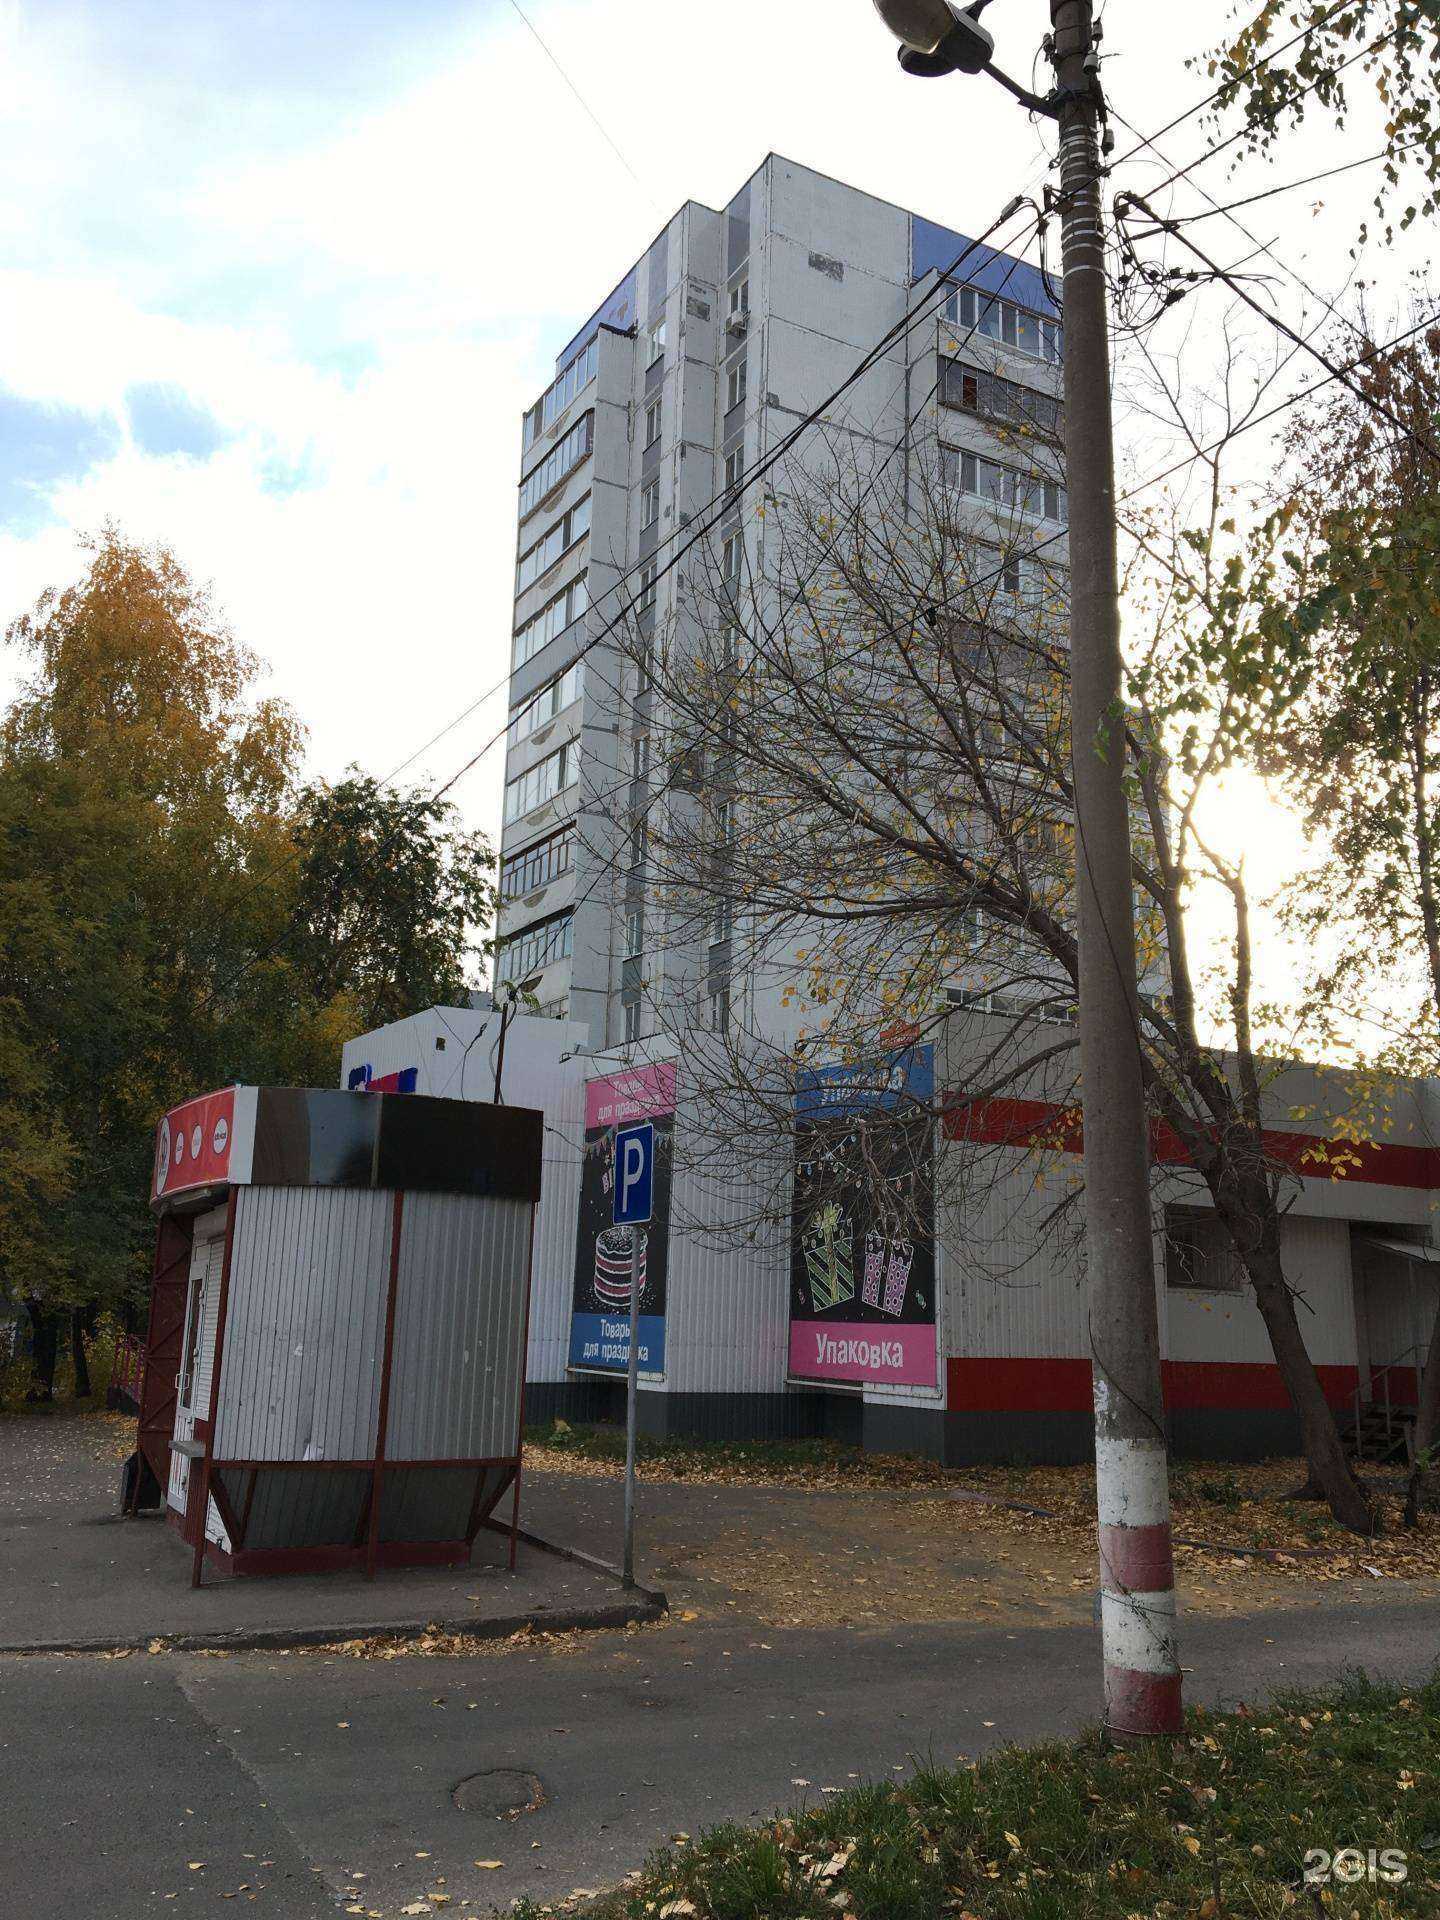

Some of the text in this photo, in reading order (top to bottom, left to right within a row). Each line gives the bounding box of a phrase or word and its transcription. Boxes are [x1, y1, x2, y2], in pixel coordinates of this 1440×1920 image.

[621, 1138, 645, 1213] P
[582, 1343, 649, 1363] для праздка
[816, 1332, 904, 1369] Упаковка
